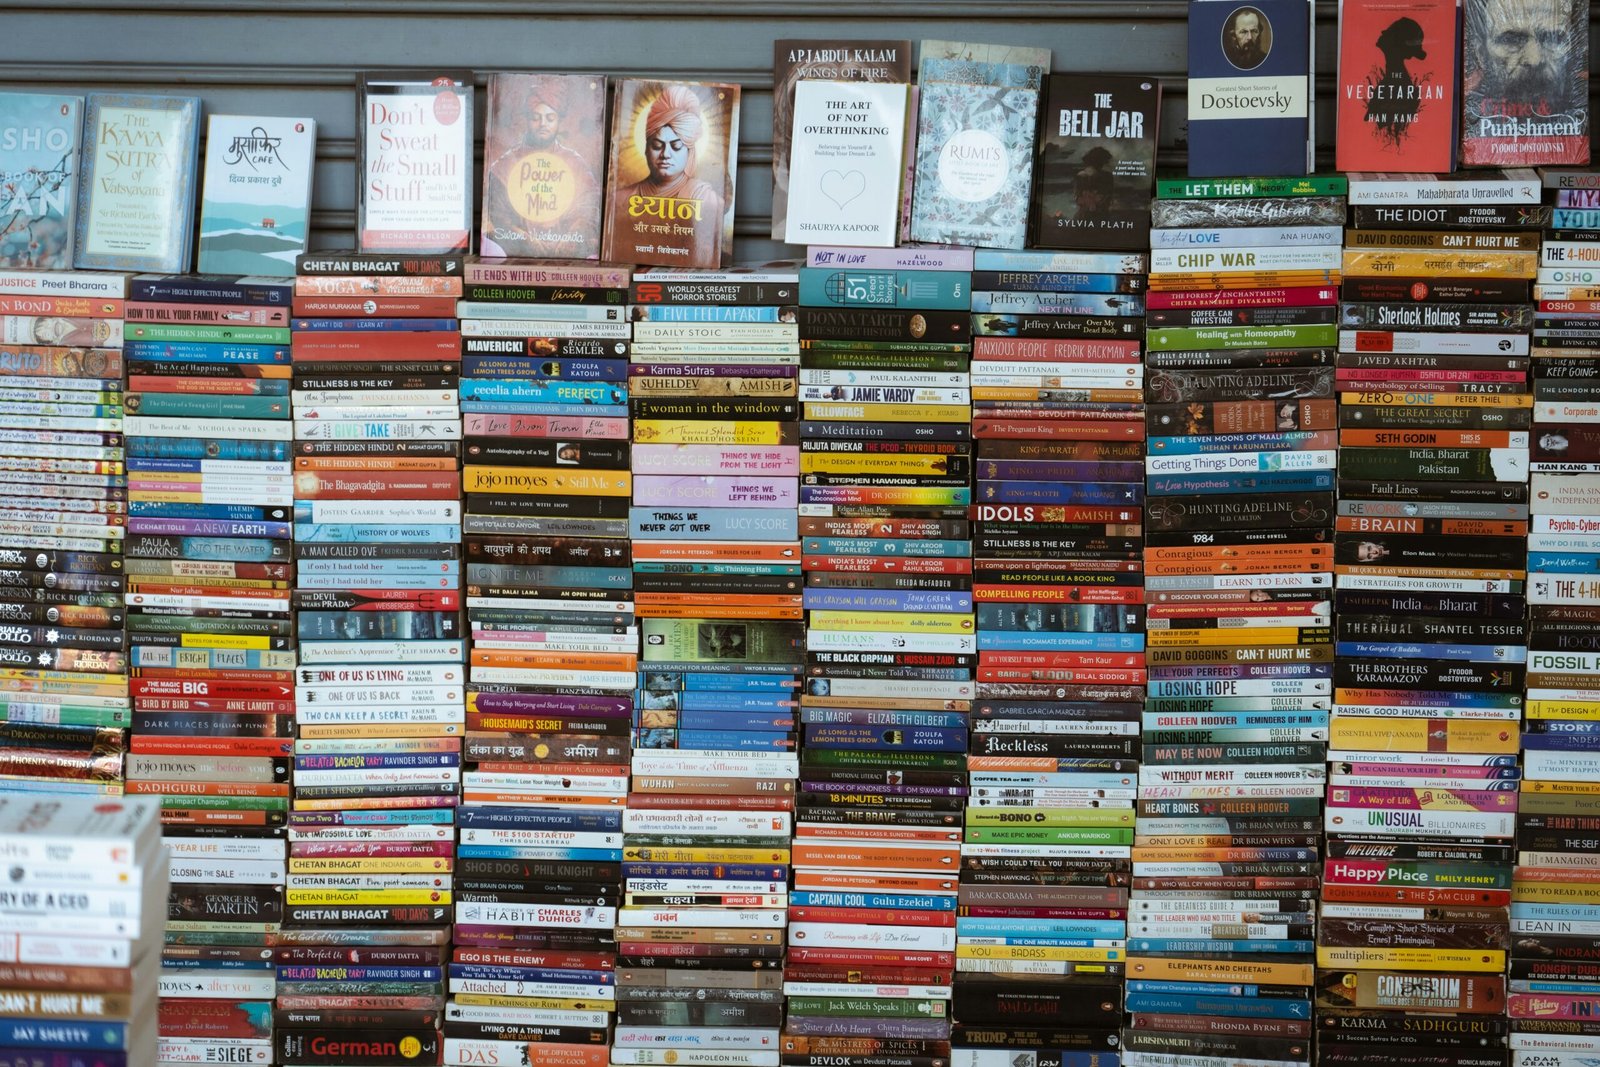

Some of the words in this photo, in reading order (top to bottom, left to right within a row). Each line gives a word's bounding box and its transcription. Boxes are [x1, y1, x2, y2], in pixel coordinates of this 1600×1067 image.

[1346, 84, 1443, 100] VEGETARIAN
[826, 101, 846, 109] THE
[1094, 93, 1112, 108] THE
[1201, 93, 1292, 112] Dostoevsky
[370, 103, 425, 126] Don't
[828, 114, 840, 122] OF
[844, 114, 868, 122] NOT
[1368, 113, 1388, 122] HAN
[1394, 114, 1419, 123] KANG
[1059, 110, 1101, 138] BELL
[1105, 111, 1143, 138] JAR
[1480, 117, 1581, 138] Punishment
[804, 126, 889, 136] OVERTHINKING
[380, 129, 438, 151] Sweat
[252, 156, 273, 164] CAFE
[371, 158, 395, 175] the
[398, 155, 457, 176] Small
[370, 180, 425, 202] Stuff
[1169, 186, 1182, 194] THE
[1185, 184, 1209, 195] LET
[1213, 184, 1253, 194] THEM
[1257, 185, 1286, 193] THEORY
[628, 195, 702, 221] ध्यान
[1376, 209, 1403, 221] THE
[1407, 210, 1446, 221] IDIOT
[633, 223, 647, 233] और
[649, 223, 670, 235] उसके
[673, 224, 694, 236] नियम
[800, 223, 839, 231] SHAURYA
[842, 224, 879, 232] KAPOOR
[1058, 219, 1094, 228] SYLVIA
[1101, 220, 1134, 228] PLATH
[1178, 254, 1216, 267] CHIP
[1220, 253, 1255, 267] WAR
[303, 261, 350, 271] CHETAN
[353, 261, 400, 271] BHAGAT
[403, 260, 416, 273] 400
[419, 261, 441, 273] DAYS
[42, 280, 66, 289] Preet
[69, 280, 107, 290] Bharara
[672, 293, 703, 301] HORROR
[706, 293, 737, 301] STORIES
[127, 308, 144, 319] HOW
[146, 308, 154, 319] TO
[156, 309, 171, 320] KILL
[173, 310, 191, 320] YOUR
[194, 310, 219, 321] FAMILY
[1378, 307, 1422, 325] Sherlock
[1424, 309, 1460, 326] Holmes
[1196, 330, 1227, 341] Healing
[1244, 328, 1296, 340] Homeopathy
[467, 341, 523, 353] MAVERICK!
[224, 351, 258, 360] PEASE
[651, 366, 682, 375] Karma
[685, 366, 715, 376] Sutras
[474, 386, 506, 396] cecelia
[509, 386, 542, 396] ahern
[558, 387, 605, 400] PERFECT
[851, 387, 879, 401] JAMIE
[882, 388, 915, 402] VARDY
[1359, 392, 1393, 404] ZERO
[1405, 392, 1434, 404] ONE
[1482, 396, 1501, 404] THIEL
[650, 404, 692, 413] woman
[697, 403, 708, 413] in
[712, 403, 730, 413] the
[734, 403, 781, 413] window
[1376, 433, 1400, 444] SETH
[1403, 433, 1436, 444] GODIN
[1152, 460, 1191, 472] Getting
[1193, 459, 1226, 470] Things
[1229, 457, 1257, 468] Done
[475, 471, 501, 488] jojo
[505, 474, 547, 487] moyes
[653, 512, 683, 521] THINGS
[977, 506, 1034, 521] IDOLS
[1073, 512, 1114, 521] AMISH
[194, 522, 202, 533] A
[204, 523, 228, 534] NEW
[232, 524, 266, 534] EARTH
[640, 524, 667, 532] NEVER
[671, 524, 688, 532] GOT
[690, 523, 710, 532] OVER
[1360, 519, 1416, 532] BRAIN
[1193, 534, 1214, 543] 1984
[1424, 624, 1474, 634] SHANTEL
[1480, 625, 1523, 635] TESSIER
[1350, 664, 1371, 673] THE
[1373, 665, 1428, 674] BROTHERS
[1534, 656, 1591, 670] FOSSIL
[1356, 674, 1422, 684] KARAMAZOV
[183, 682, 208, 694] BIG
[1159, 681, 1203, 696] LOSING
[1207, 680, 1237, 695] HOPE
[142, 700, 159, 709] BIRD
[161, 700, 170, 709] BY
[172, 700, 189, 709] BIRD
[226, 701, 246, 710] ANNE
[248, 702, 274, 711] LAMOTT
[484, 718, 534, 730] HOUSEMAID'S
[536, 720, 562, 730] SECRET
[493, 745, 506, 756] का
[564, 744, 598, 758] अमीश
[1368, 811, 1424, 827] UNUSUAL
[171, 868, 202, 878] CLOSING
[216, 870, 234, 878] SALE
[1334, 865, 1386, 883] Happy
[1388, 867, 1428, 882] Place
[1435, 875, 1465, 883] EMILY
[1466, 875, 1495, 884] HENRY
[463, 893, 498, 904] Warmth
[809, 893, 842, 906] CAPTAIN
[845, 894, 866, 907] COOL
[873, 897, 894, 907] Gulu
[898, 897, 933, 908] Ezekiel
[206, 903, 258, 914] MARTIN
[538, 908, 582, 917] CHARLES
[486, 911, 535, 923] HABIT
[1518, 921, 1554, 931] LEAN
[1558, 922, 1571, 932] IN
[460, 953, 479, 963] EGO
[482, 954, 490, 963] IS
[493, 954, 511, 963] THE
[513, 954, 545, 964] ENEMY
[1330, 951, 1384, 962] multipliers
[1168, 963, 1214, 971] ELEPHANTS
[1217, 964, 1231, 972] AND
[1232, 964, 1272, 973] CHEETAHS
[828, 1002, 845, 1012] Jack
[848, 1001, 871, 1012] Welch
[874, 1002, 899, 1013] Speaks
[1341, 1018, 1387, 1029] KARMA
[1403, 1020, 1490, 1033] SADHGURU
[966, 1032, 1006, 1044] TRUMP
[311, 1037, 396, 1056] German
[218, 1048, 253, 1062] SIEGE
[810, 1056, 850, 1065] DEVLOK
